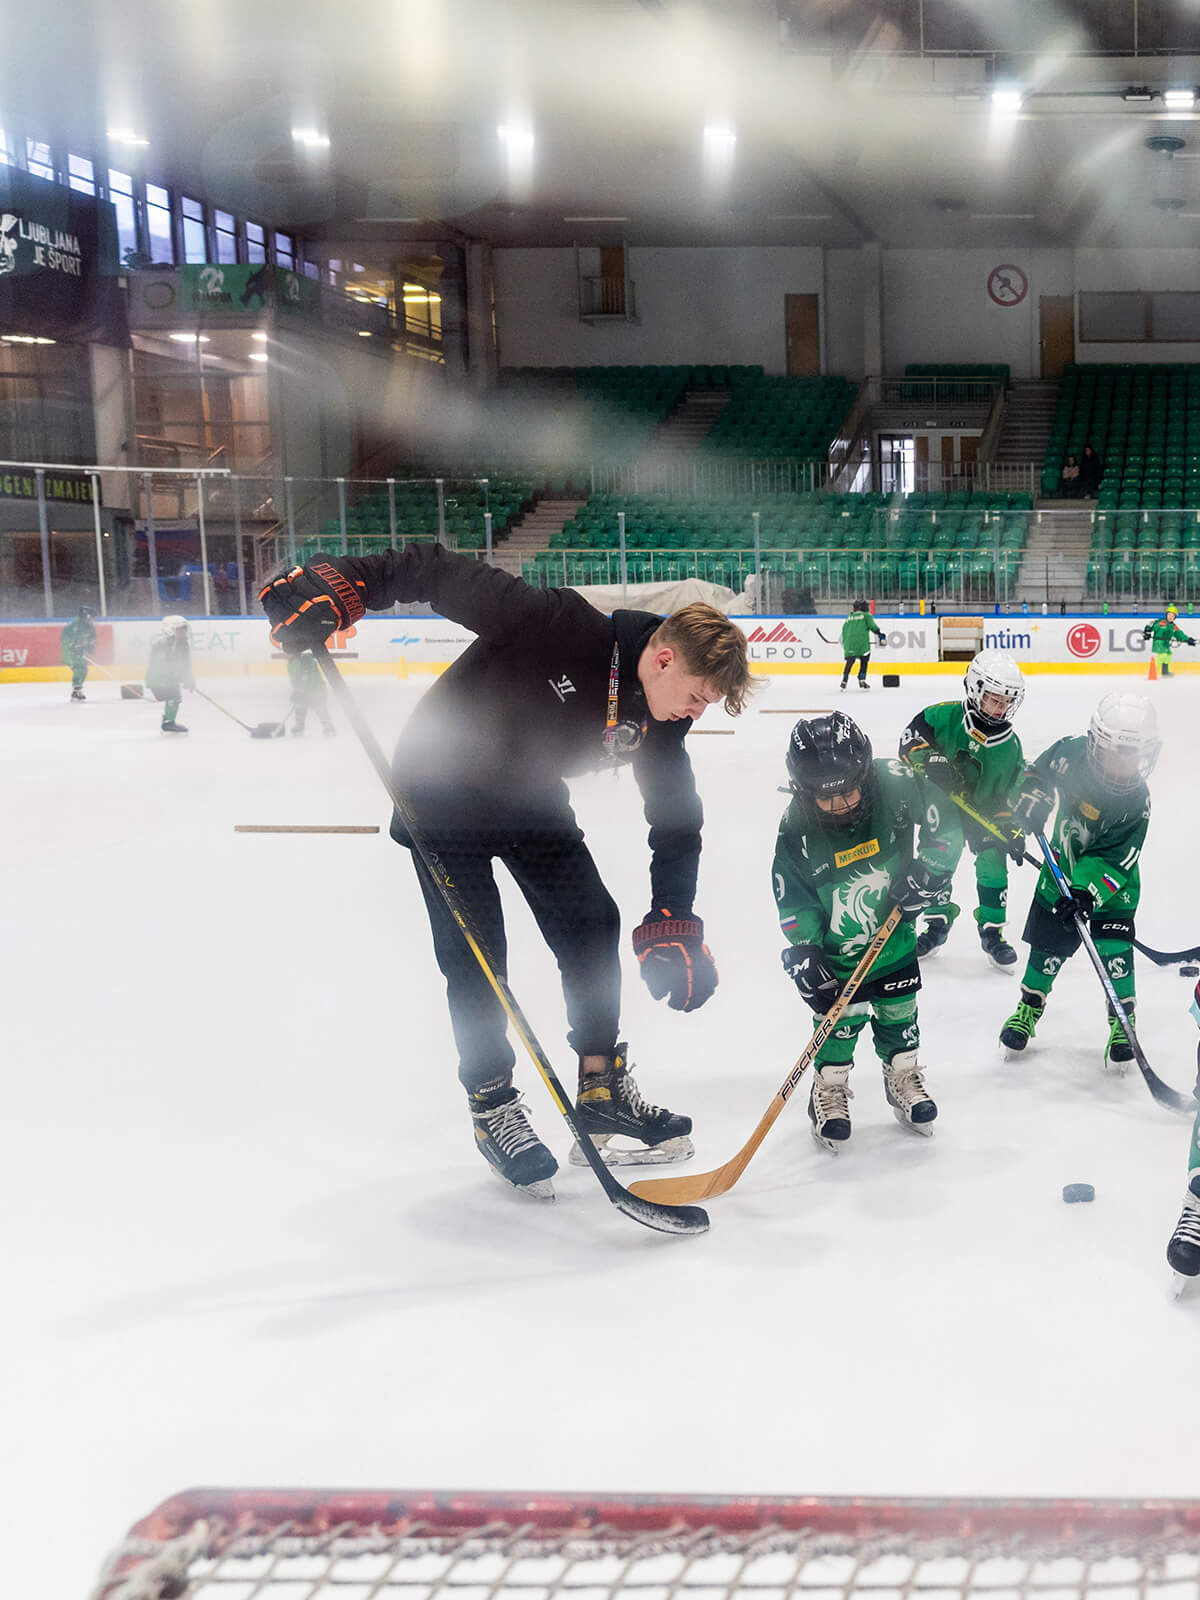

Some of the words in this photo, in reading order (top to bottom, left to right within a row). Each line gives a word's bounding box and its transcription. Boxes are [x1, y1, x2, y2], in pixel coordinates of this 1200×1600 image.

[19, 217, 81, 256] LJUBLJANA
[33, 245, 46, 267] JE
[48, 247, 81, 276] SPORT
[190, 632, 241, 650] EAT
[1108, 628, 1147, 652] LG
[0, 647, 28, 666] ay
[751, 647, 813, 659] LPOD
[1101, 923, 1130, 932] CCM
[884, 976, 919, 991] CCM
[782, 1018, 833, 1102] FISCHER
